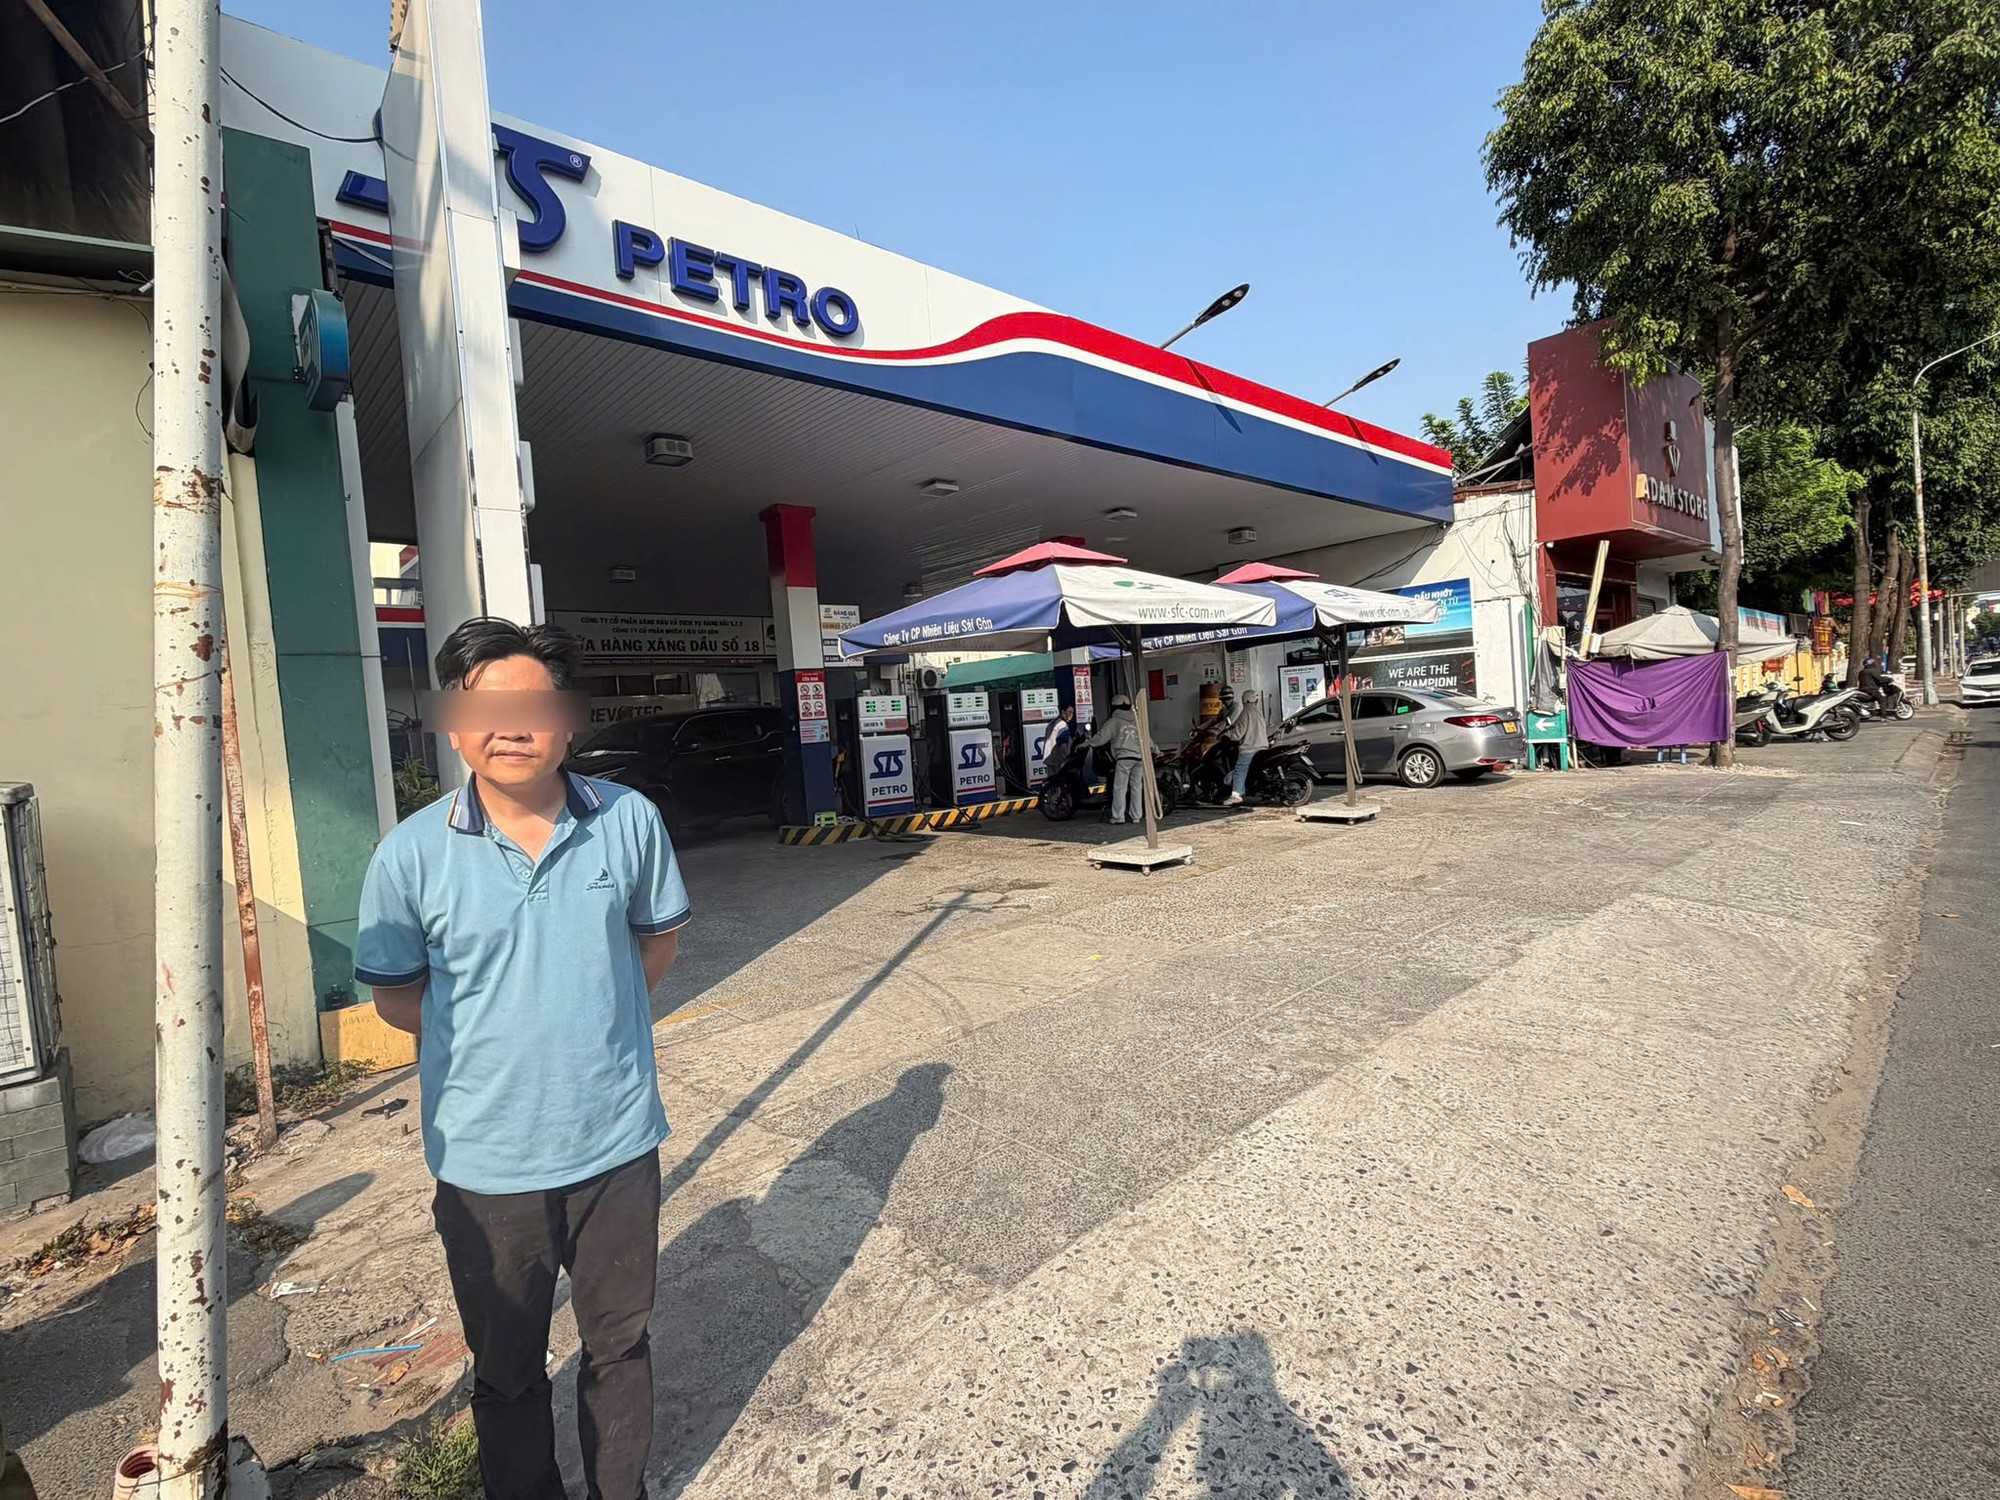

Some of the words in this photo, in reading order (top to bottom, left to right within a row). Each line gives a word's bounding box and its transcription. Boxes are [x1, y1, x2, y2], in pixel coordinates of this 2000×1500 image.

[613, 219, 859, 337] PETRO
[1637, 474, 1675, 508] ADAM
[1677, 488, 1708, 520] STORE
[883, 633, 901, 646] Công
[901, 629, 909, 642] Ty
[910, 627, 921, 640] CP
[922, 624, 942, 638] Nhiên
[943, 622, 959, 636] Liệu
[1164, 635, 1173, 646] CP
[601, 637, 642, 651] HÀNG
[648, 637, 685, 651] XĂNG
[690, 636, 717, 651] DẦU
[722, 635, 739, 651] SỐ
[744, 640, 760, 651] 18
[1388, 668, 1405, 679] WE
[1406, 666, 1427, 677] ARE
[1429, 663, 1450, 675] THE
[1397, 676, 1457, 688] CHAMPION!
[1033, 767, 1048, 776] PET
[959, 774, 990, 786] PETRO
[871, 784, 908, 796] PETRO
